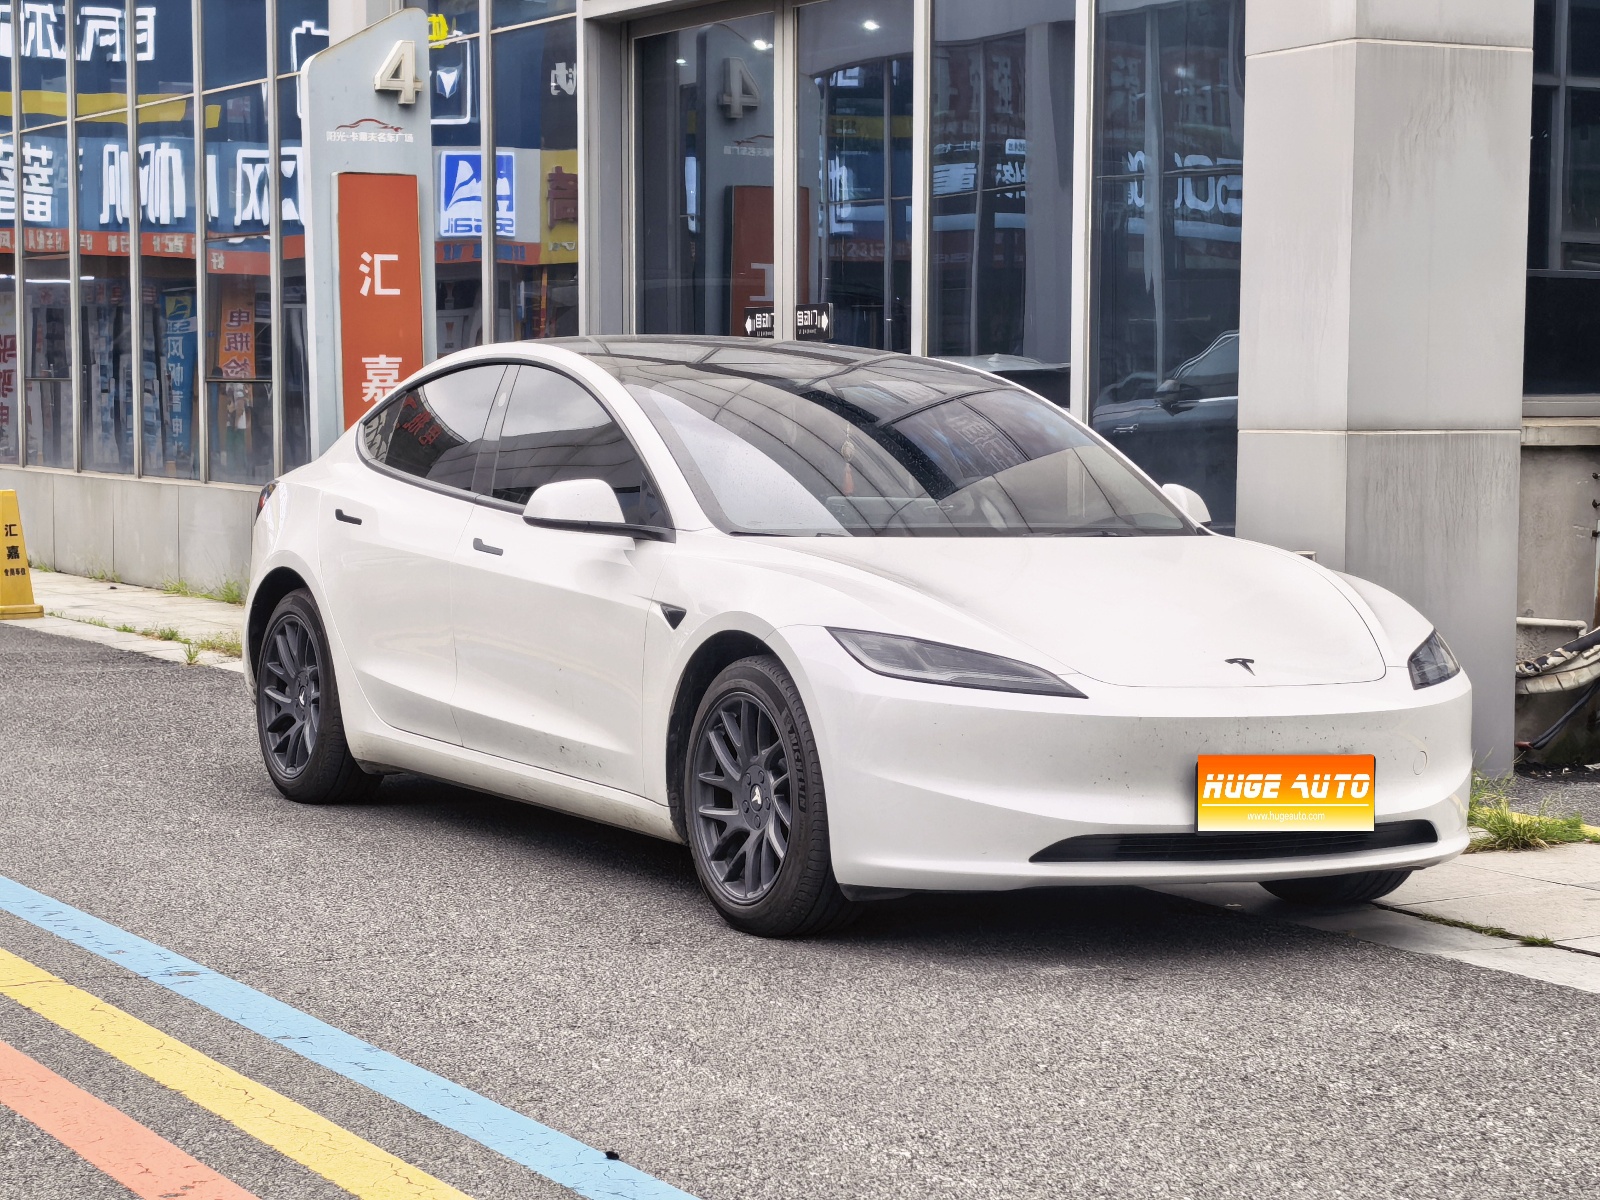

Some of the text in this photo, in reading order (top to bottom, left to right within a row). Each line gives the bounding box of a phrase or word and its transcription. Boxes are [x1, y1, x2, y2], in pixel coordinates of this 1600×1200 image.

[374, 40, 423, 104] 4
[358, 251, 402, 403] 汇嘉
[797, 310, 818, 326] 自动门
[4, 524, 20, 560] 汇嘉
[789, 733, 807, 809] MICHELIN
